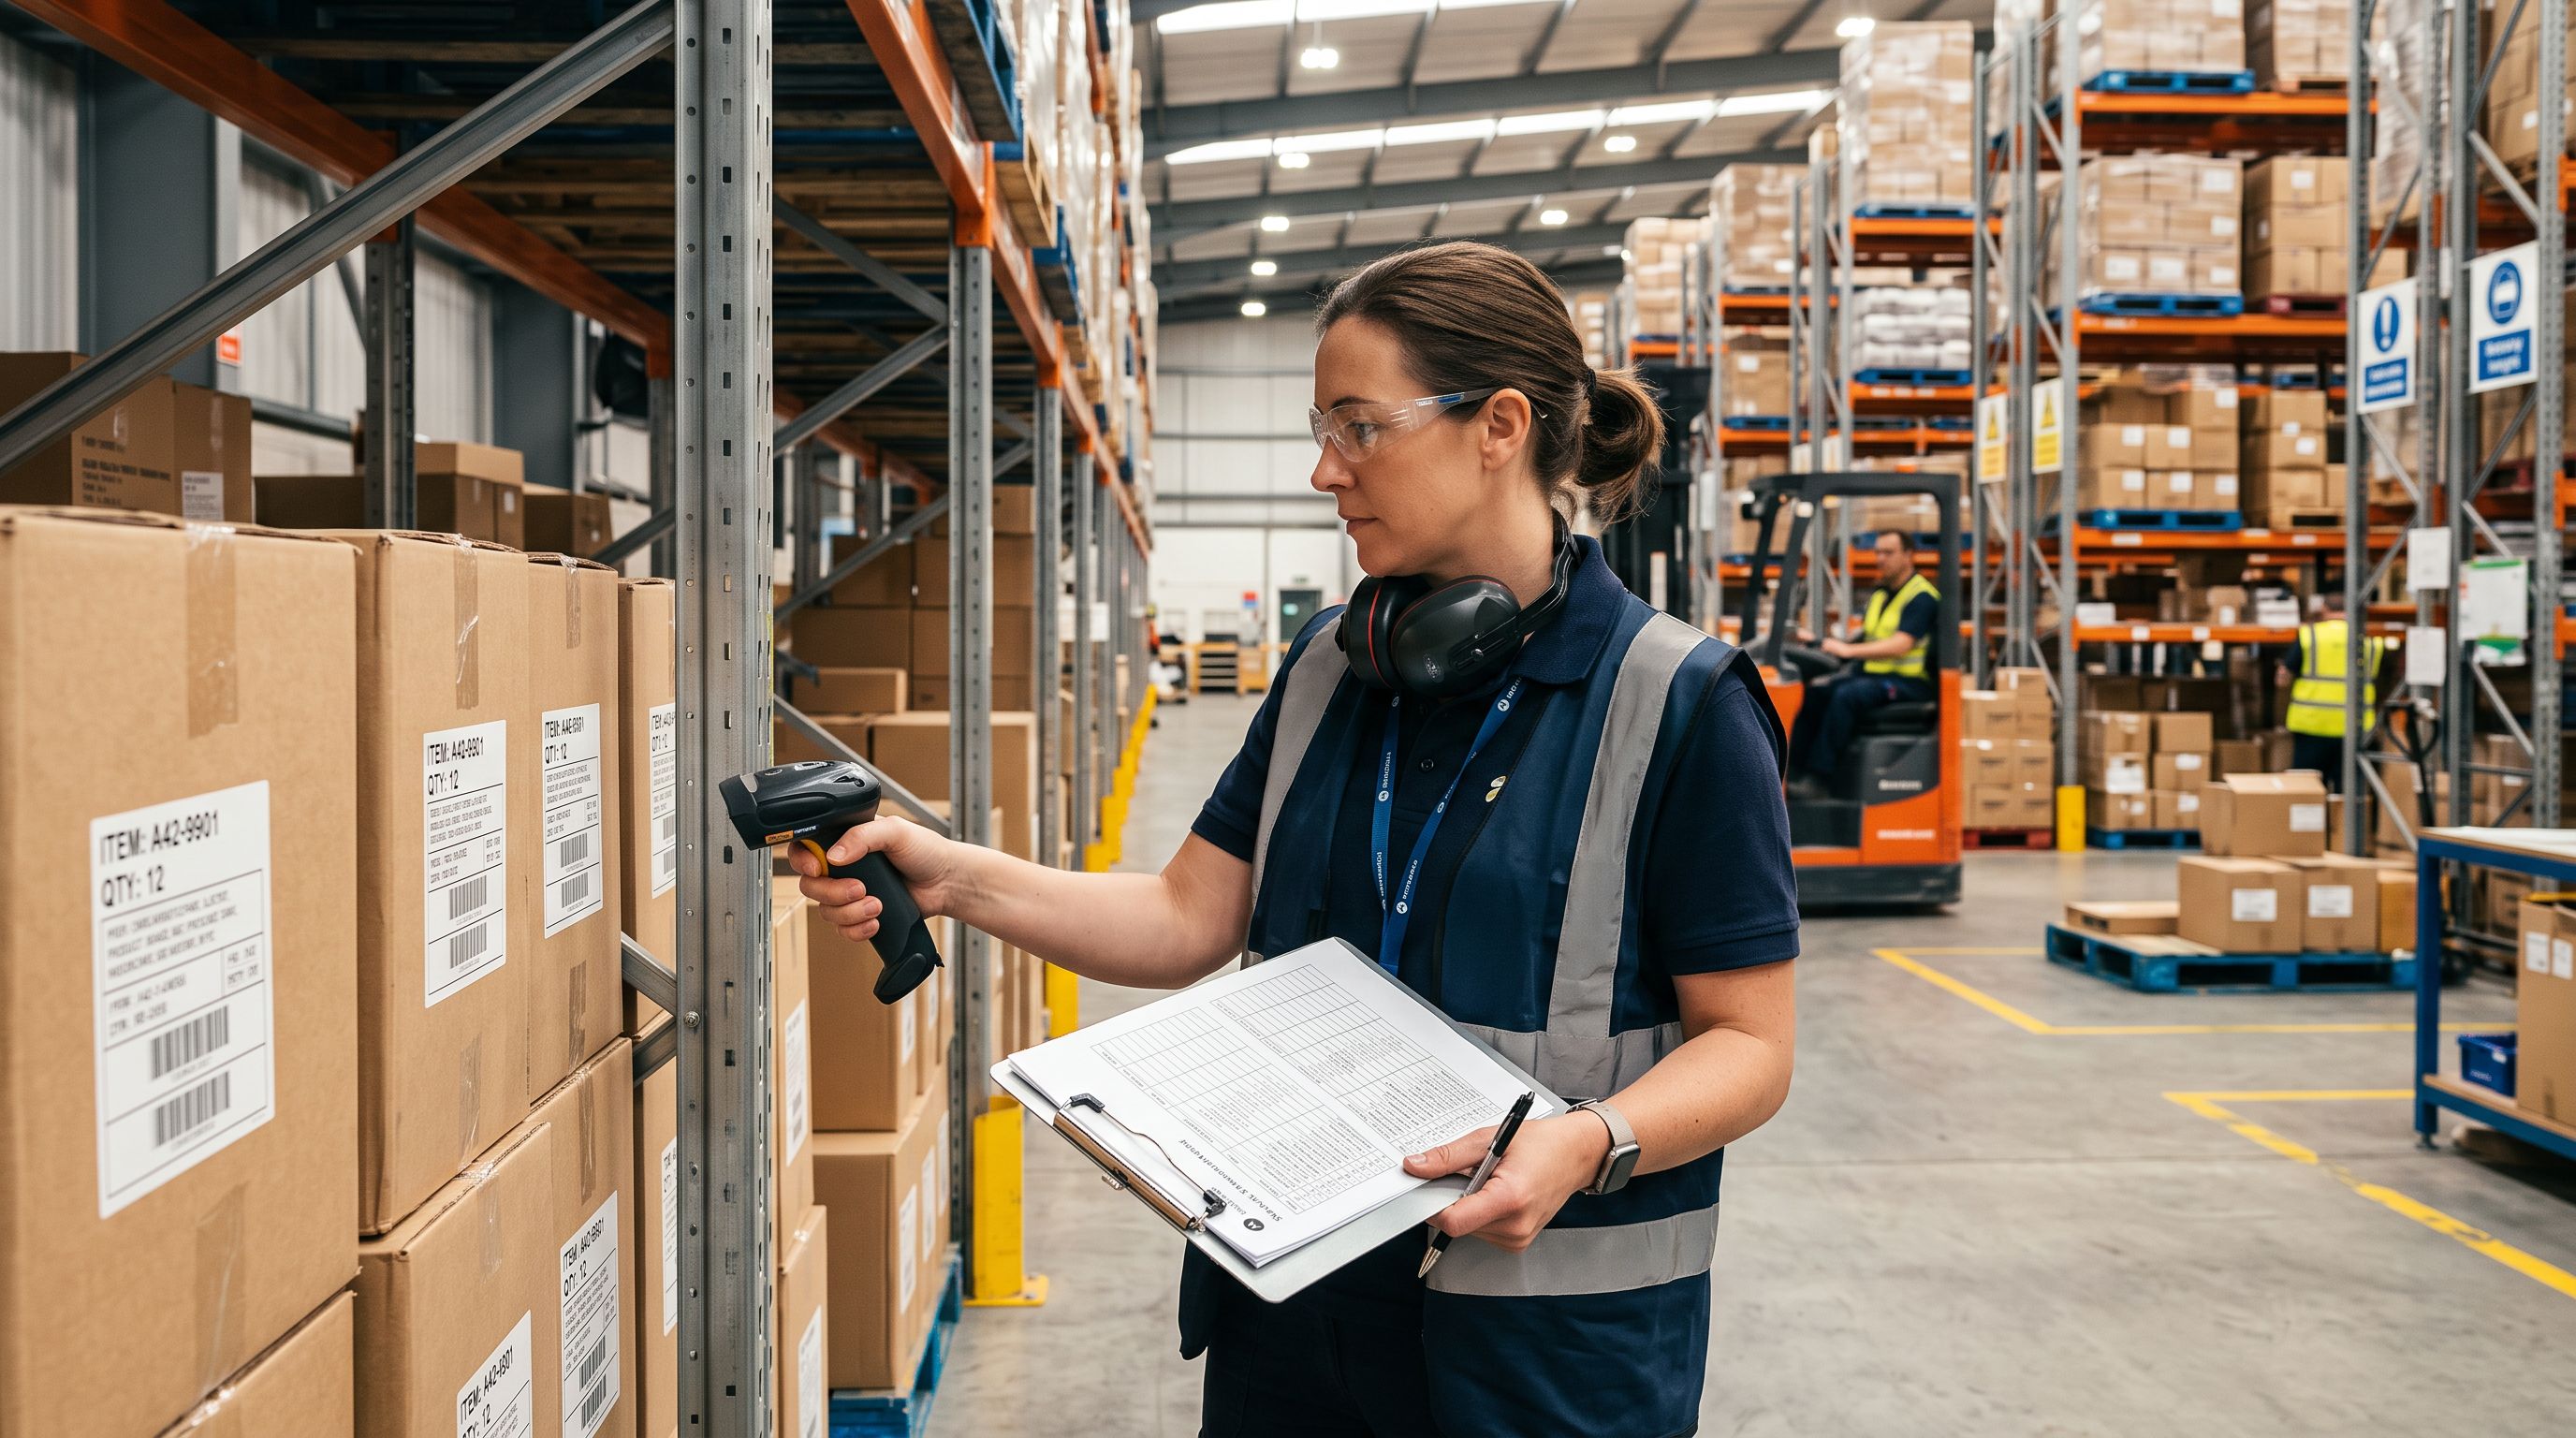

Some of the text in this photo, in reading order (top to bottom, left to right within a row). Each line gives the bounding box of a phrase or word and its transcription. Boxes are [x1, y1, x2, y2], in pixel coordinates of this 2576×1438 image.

[428, 742, 449, 766] ITEM:
[561, 742, 567, 760] 12
[428, 770, 459, 796] QTY: 12
[100, 809, 220, 865] ITEM: A42-9901
[101, 865, 164, 907] QTY: 12
[580, 1260, 587, 1280] 12
[461, 1386, 482, 1425] ITEM:
[461, 1403, 491, 1438] TY: 12
